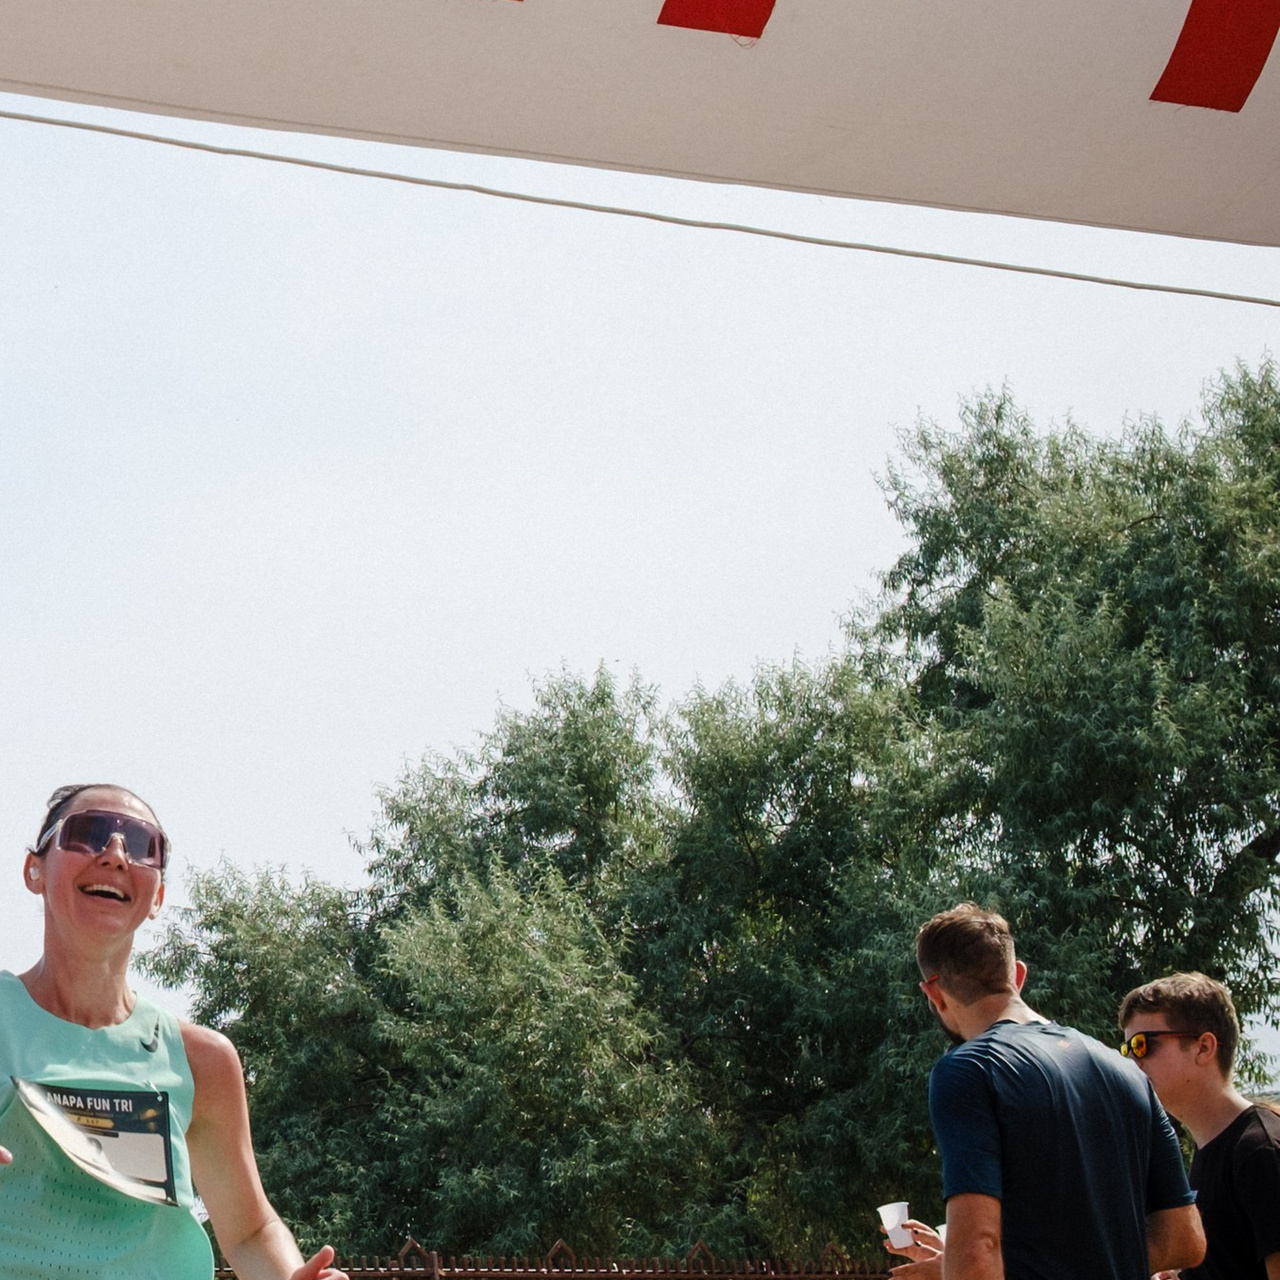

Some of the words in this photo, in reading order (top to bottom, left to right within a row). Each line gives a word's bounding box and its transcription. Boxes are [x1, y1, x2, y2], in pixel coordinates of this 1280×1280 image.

[46, 1092, 84, 1109] ANAPA
[86, 1097, 111, 1111] FUN
[113, 1099, 133, 1113] TRI
